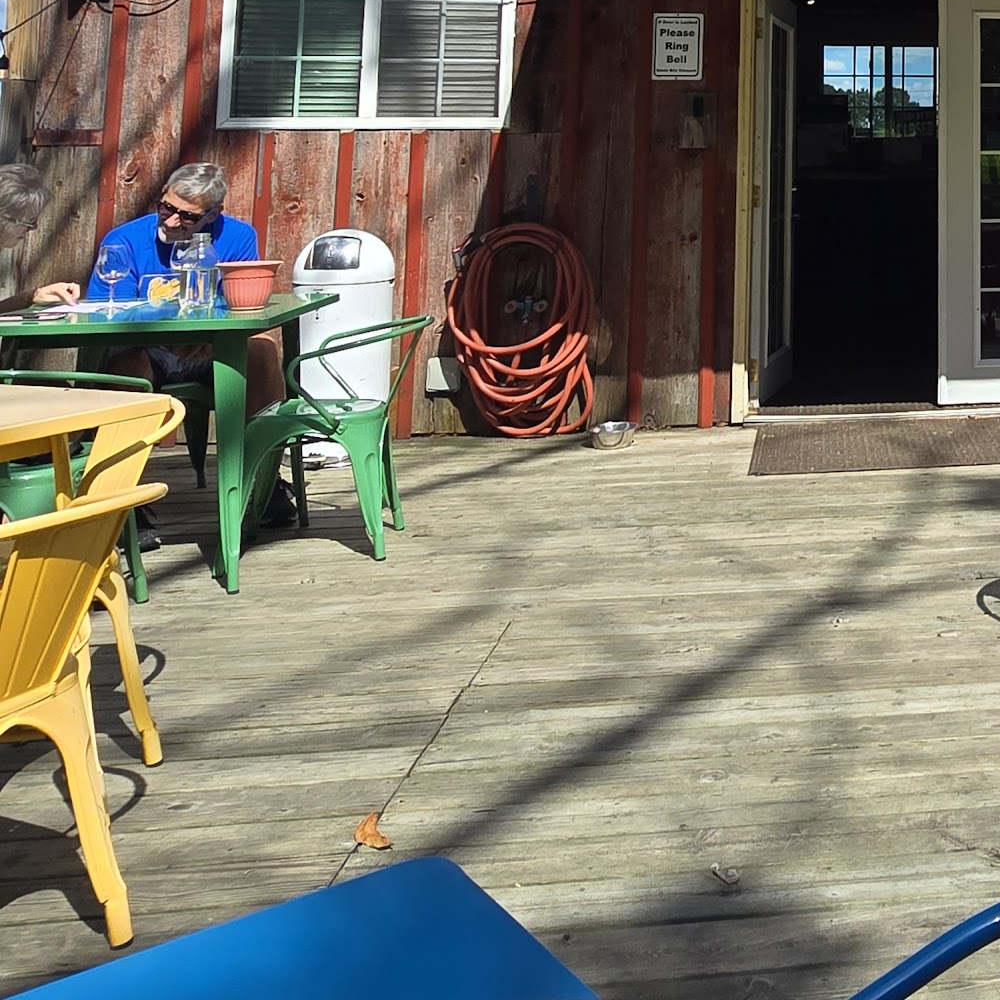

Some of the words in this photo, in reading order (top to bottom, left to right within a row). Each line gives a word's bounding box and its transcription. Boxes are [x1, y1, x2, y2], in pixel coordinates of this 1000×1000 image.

[660, 28, 695, 37] Please
[665, 42, 689, 52] Ring
[666, 55, 687, 63] Bell
